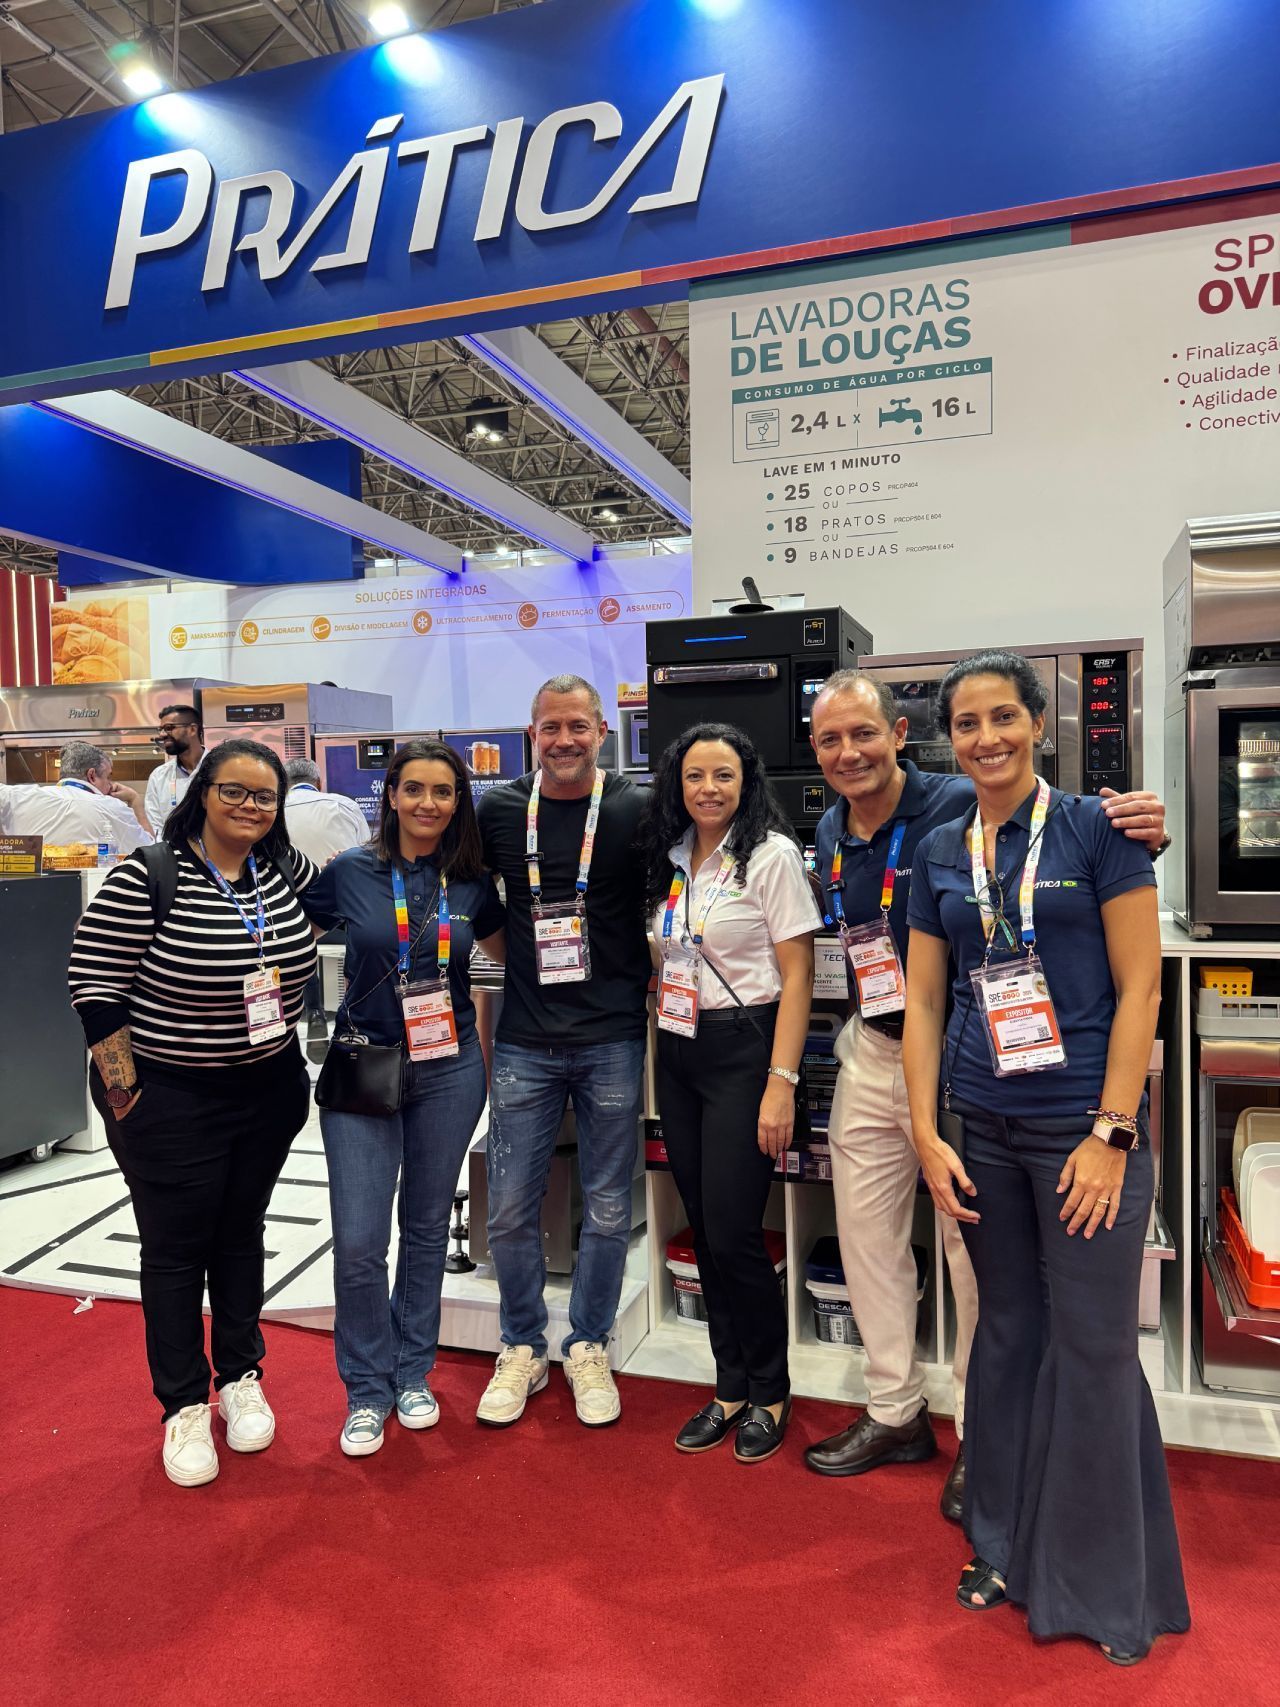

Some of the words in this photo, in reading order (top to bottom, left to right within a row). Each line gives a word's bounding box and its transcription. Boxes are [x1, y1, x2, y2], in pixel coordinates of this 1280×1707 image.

[104, 73, 725, 309] PRÁTICA
[731, 278, 970, 341] LAVADORAS
[731, 341, 783, 377] DE
[798, 316, 971, 368] LOUÇAS
[1186, 336, 1280, 361] Finalizaçã
[744, 383, 814, 400] CONSUMO
[823, 380, 840, 390] DE
[848, 373, 887, 387] ÁGUA
[896, 370, 925, 381] POR
[935, 362, 982, 376] CICLO
[1177, 362, 1270, 388] Qualidade
[932, 397, 960, 418] 16
[966, 401, 976, 415] L
[1192, 386, 1277, 411] Agilidade
[791, 410, 829, 435] 2,4
[837, 415, 846, 428] L
[763, 465, 799, 478] LAVE
[804, 461, 825, 473] EM
[830, 460, 837, 470] 1
[841, 453, 901, 469] MINUTO
[784, 483, 810, 501] 25
[823, 481, 881, 497] COPOS
[822, 501, 839, 509] OU
[784, 516, 808, 533] 18
[821, 513, 886, 530] PRATOS
[822, 534, 839, 542] OU
[784, 547, 797, 563] 9
[809, 543, 899, 562] BANDEJAS
[355, 588, 413, 604] SOLUÇÕES
[416, 584, 487, 599] INTEGRADAS
[542, 607, 593, 619] FERMENTAÇÃO
[626, 602, 672, 613] ASSAMENTO
[334, 621, 359, 631] DIVISÃO
[366, 620, 409, 630] MODELAGEM
[436, 613, 513, 624] ULTRACONGELAMENTO
[190, 630, 236, 640] AMASSAMENTO
[262, 626, 305, 635] CILINDRAGEM
[1093, 658, 1116, 666] EASY
[1005, 1007, 1033, 1018] EXPOSITOR
